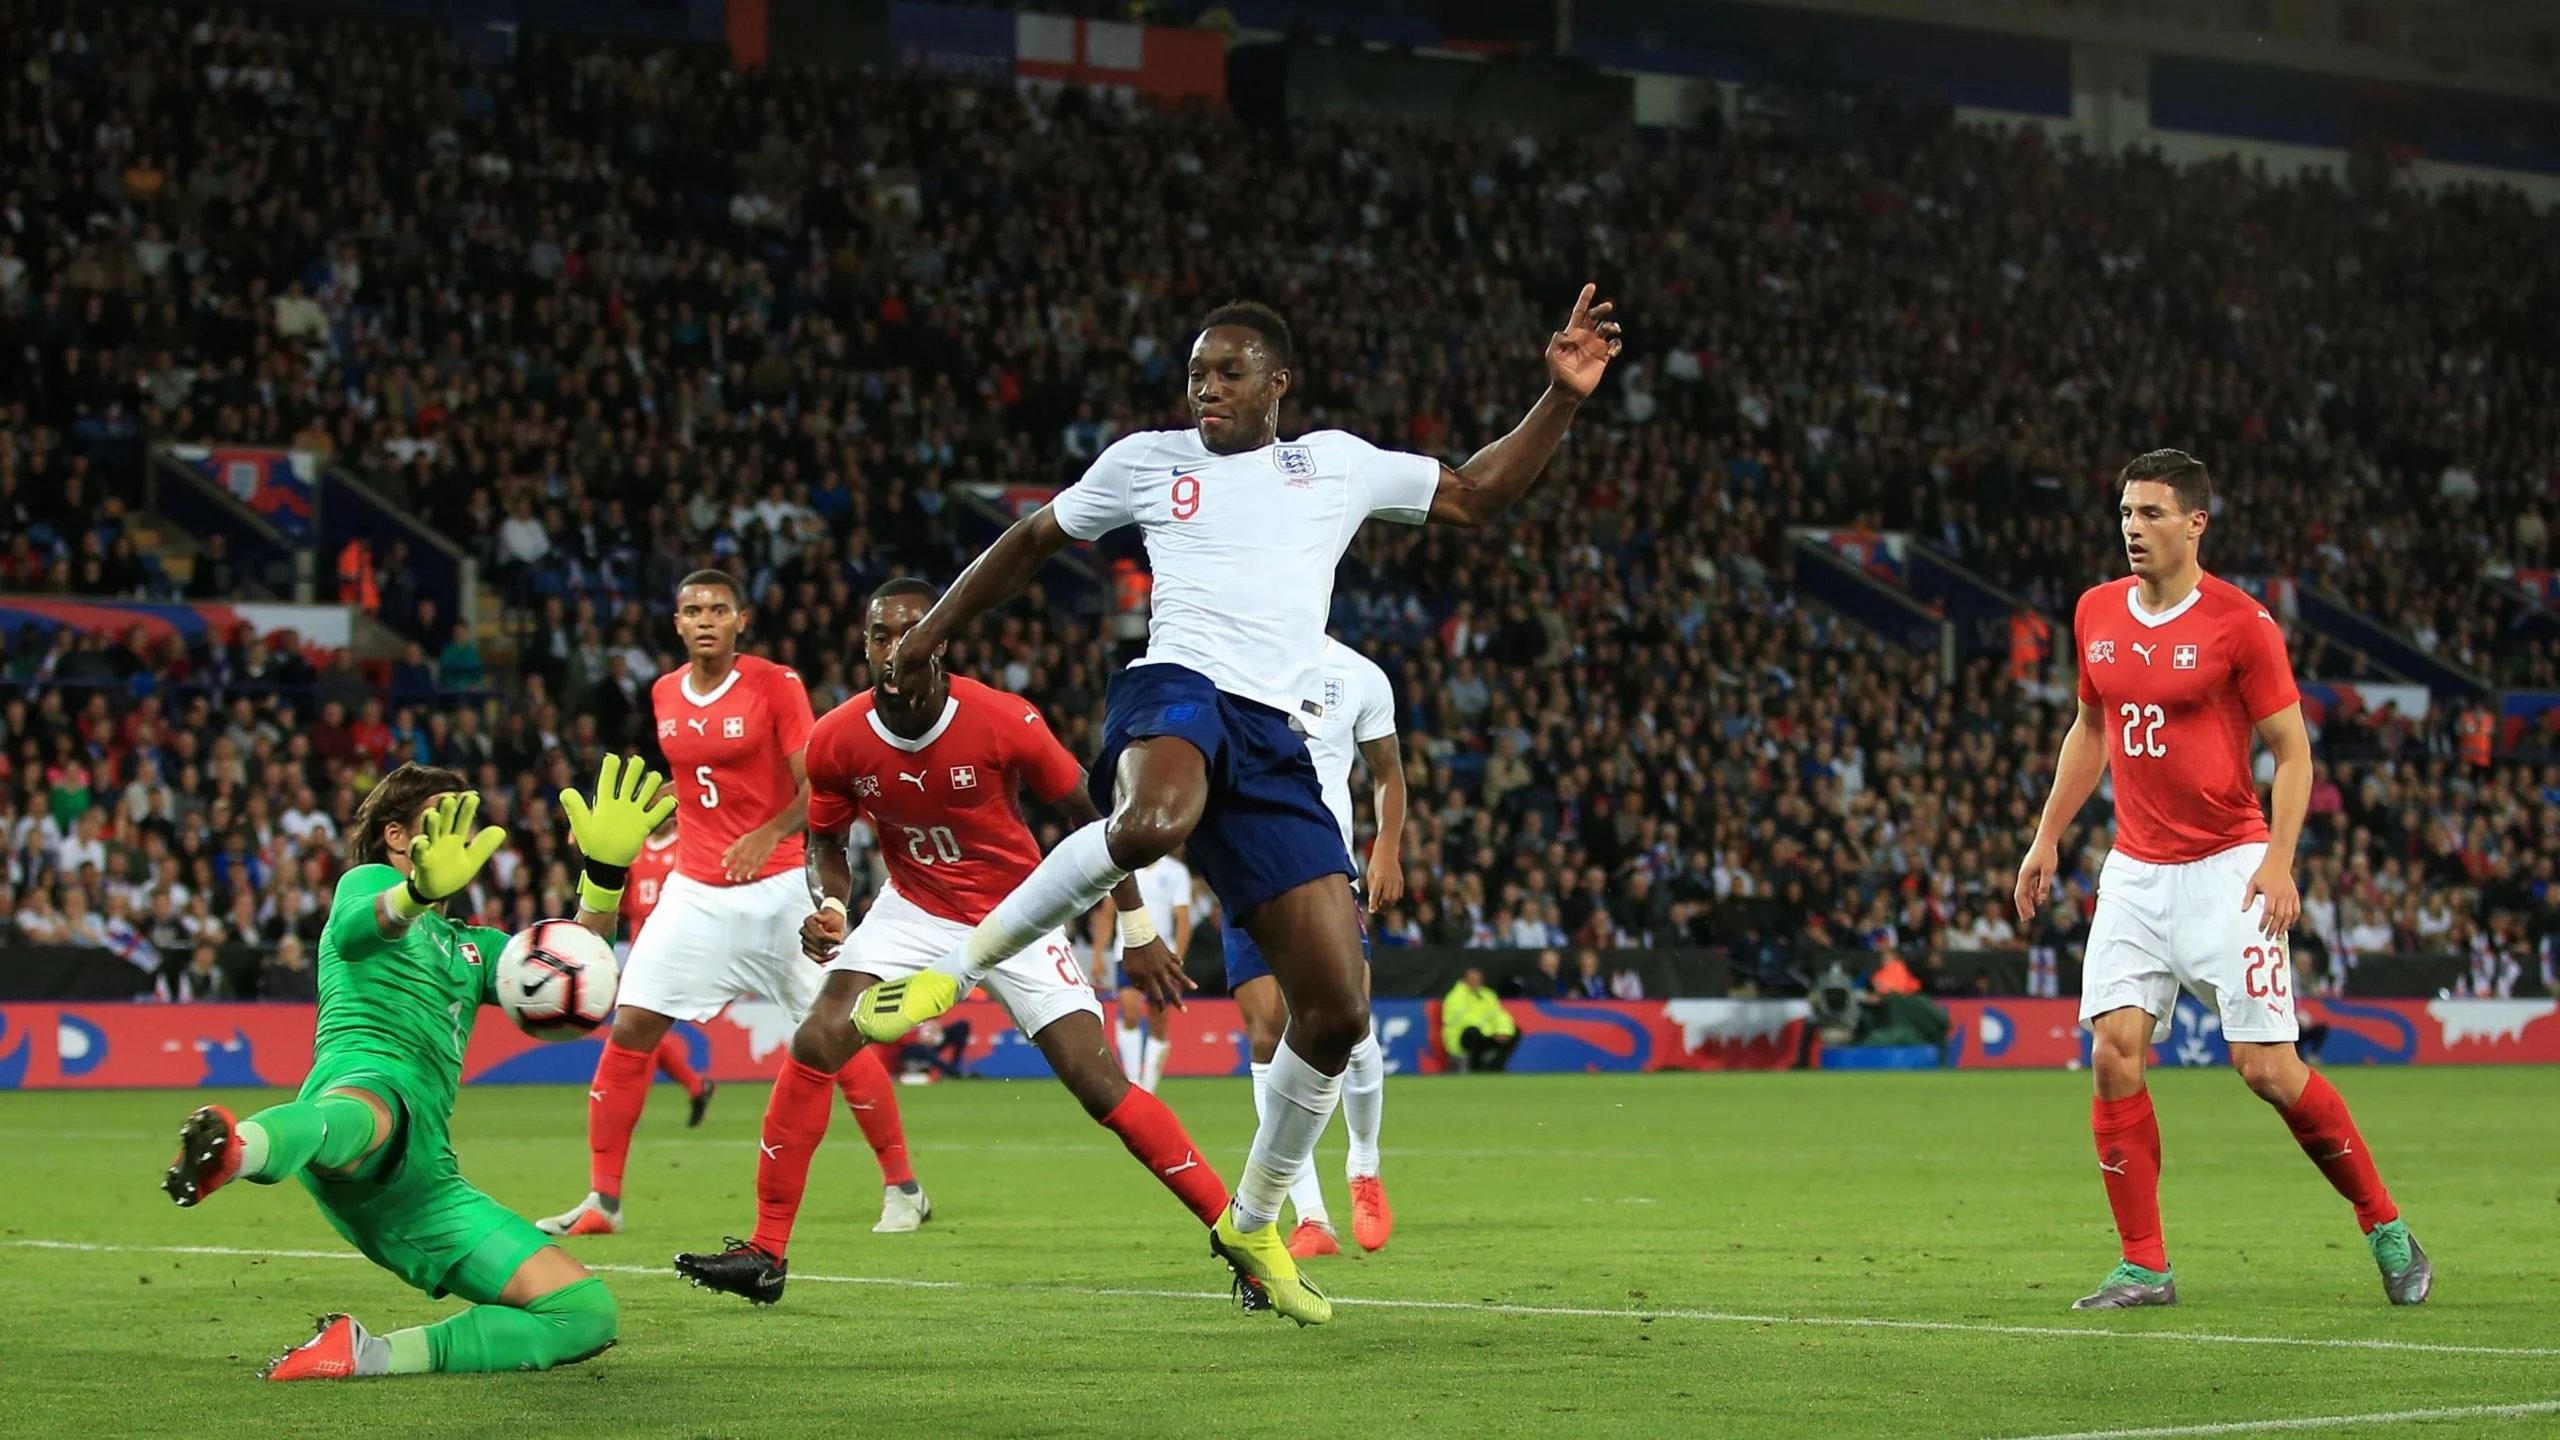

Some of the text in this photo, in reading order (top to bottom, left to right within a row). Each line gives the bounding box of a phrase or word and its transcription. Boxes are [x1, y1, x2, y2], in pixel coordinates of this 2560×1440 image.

[1172, 476, 1200, 520] 9
[2120, 702, 2166, 757] 22
[696, 765, 719, 809] 5
[903, 826, 962, 866] 20
[2243, 945, 2286, 998] 22
